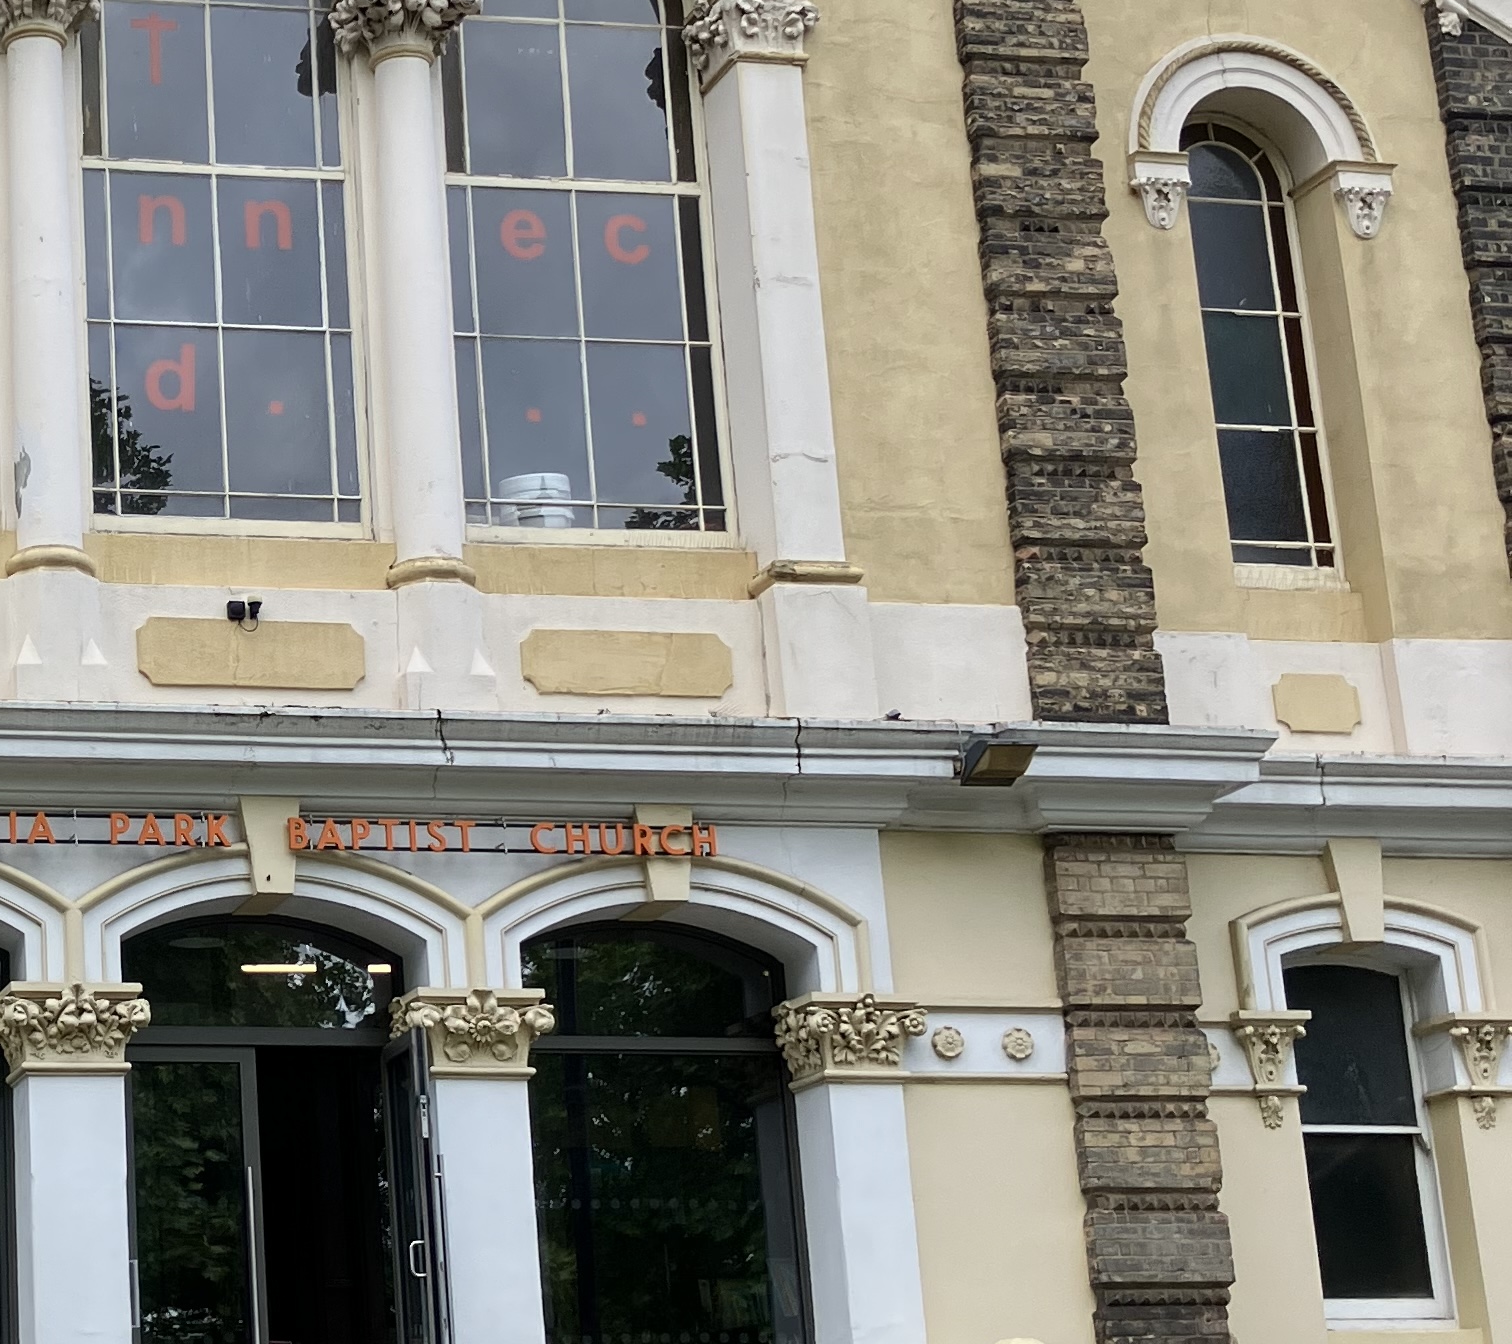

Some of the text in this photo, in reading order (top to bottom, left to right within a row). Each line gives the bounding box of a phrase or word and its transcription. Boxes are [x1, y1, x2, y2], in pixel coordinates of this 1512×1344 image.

[110, 812, 232, 847] PARK
[288, 817, 476, 853] BAPTIST
[530, 822, 717, 856] CHURCH
